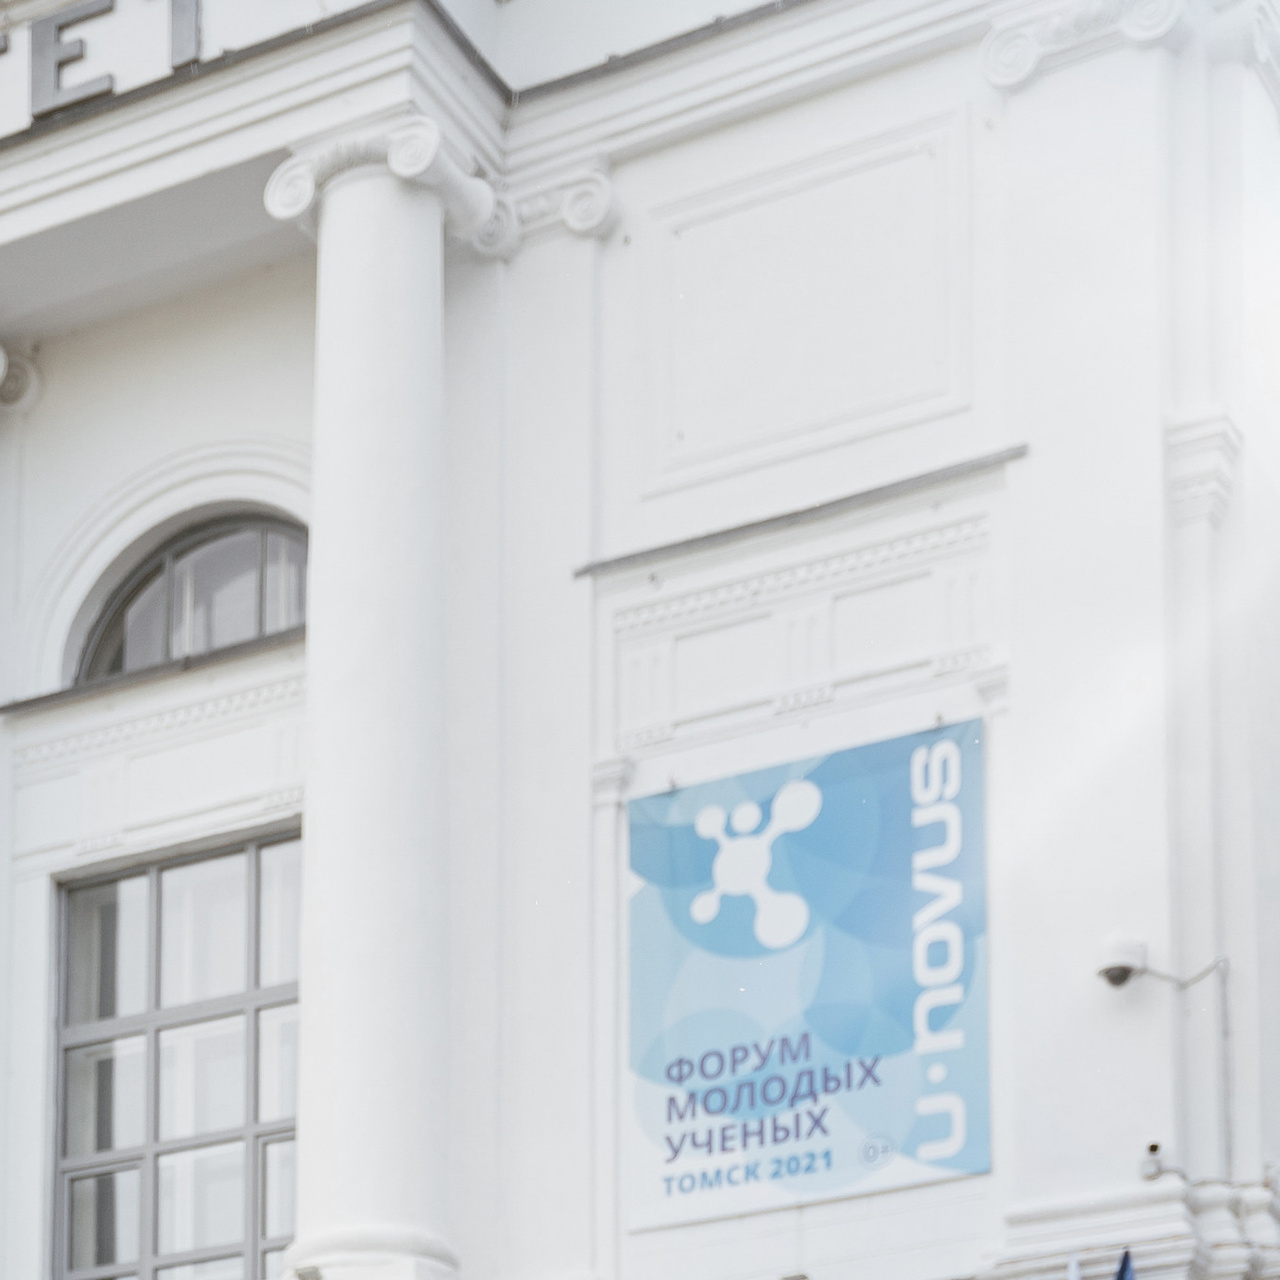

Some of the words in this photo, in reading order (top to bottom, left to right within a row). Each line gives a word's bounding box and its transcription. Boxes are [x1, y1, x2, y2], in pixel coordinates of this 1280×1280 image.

[665, 1032, 812, 1085] ФОРУМ
[666, 1054, 881, 1124] МОЛОДЫХ
[664, 1107, 830, 1164] УЧЕНЫХ
[663, 1161, 760, 1197] ТОМСК
[770, 1149, 833, 1180] 2021
